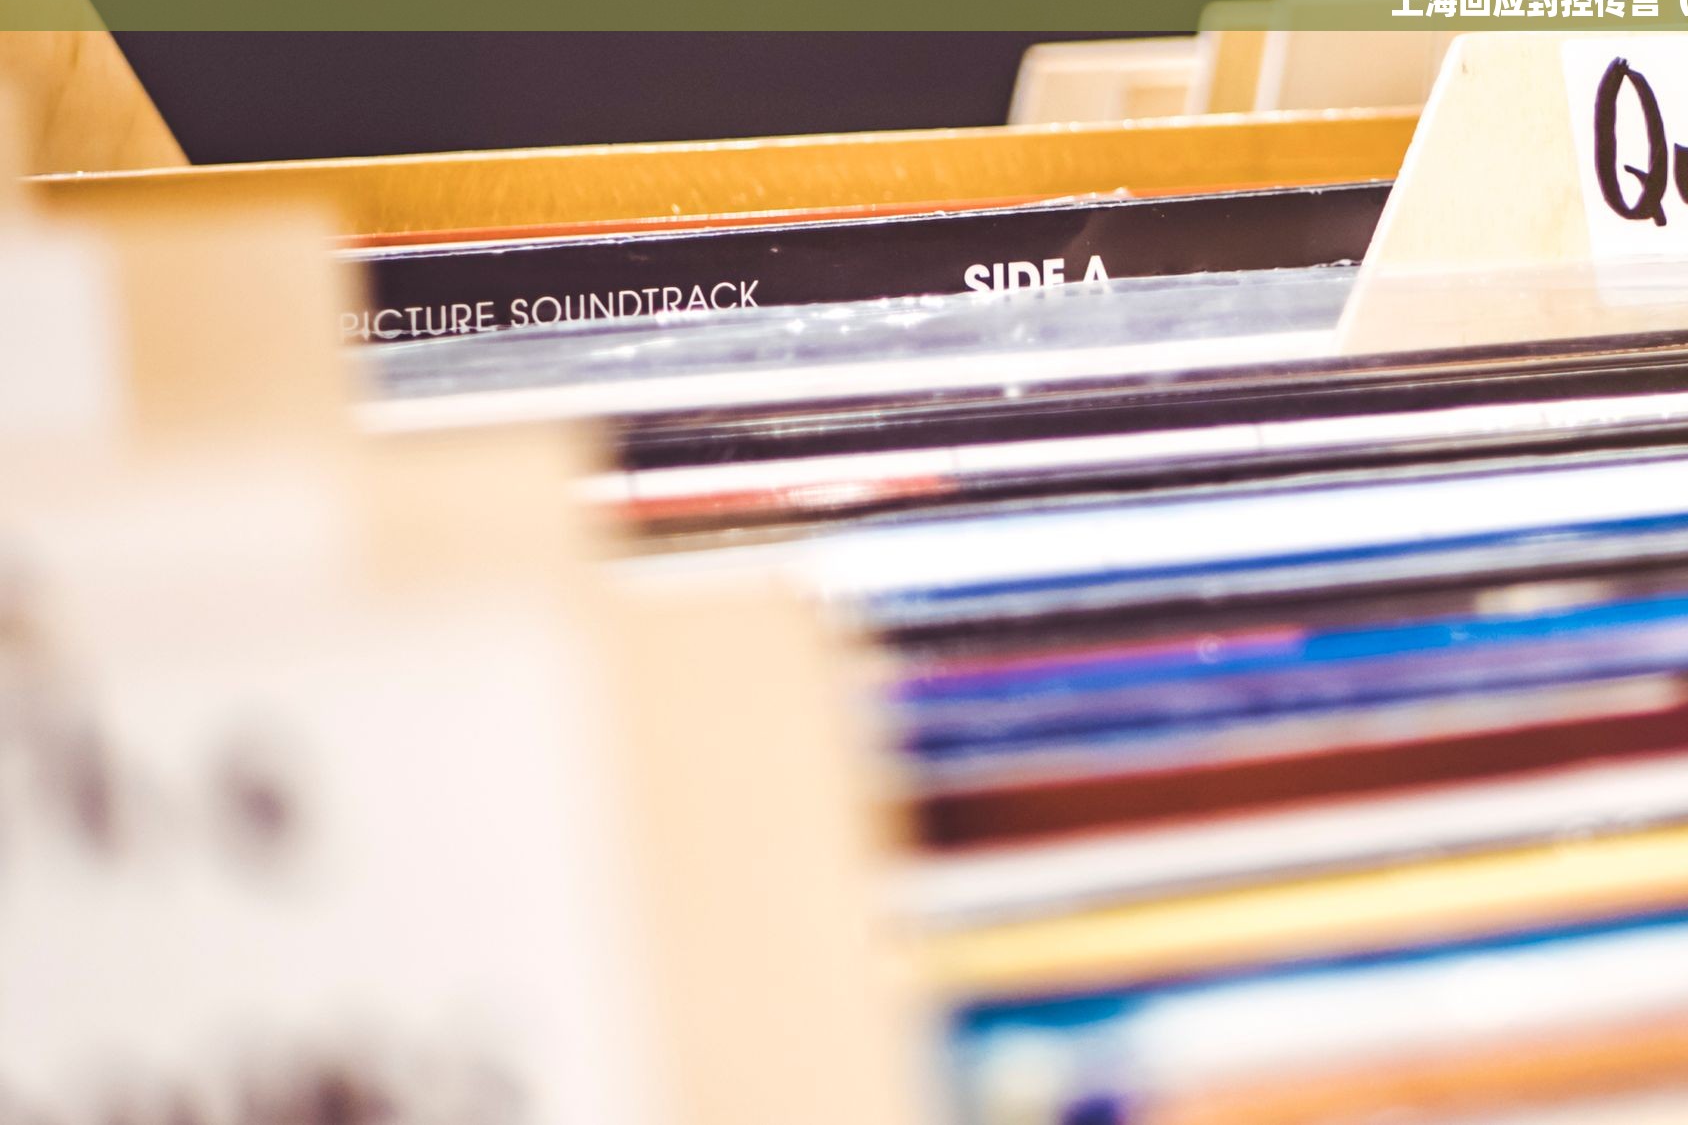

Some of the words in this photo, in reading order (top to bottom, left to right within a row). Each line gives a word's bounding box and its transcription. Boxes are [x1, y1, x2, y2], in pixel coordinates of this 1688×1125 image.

[964, 258, 1065, 294] SIDE
[1083, 255, 1109, 283] A
[339, 301, 496, 341] PICTURE
[511, 280, 760, 326] SOUNDTRACK
